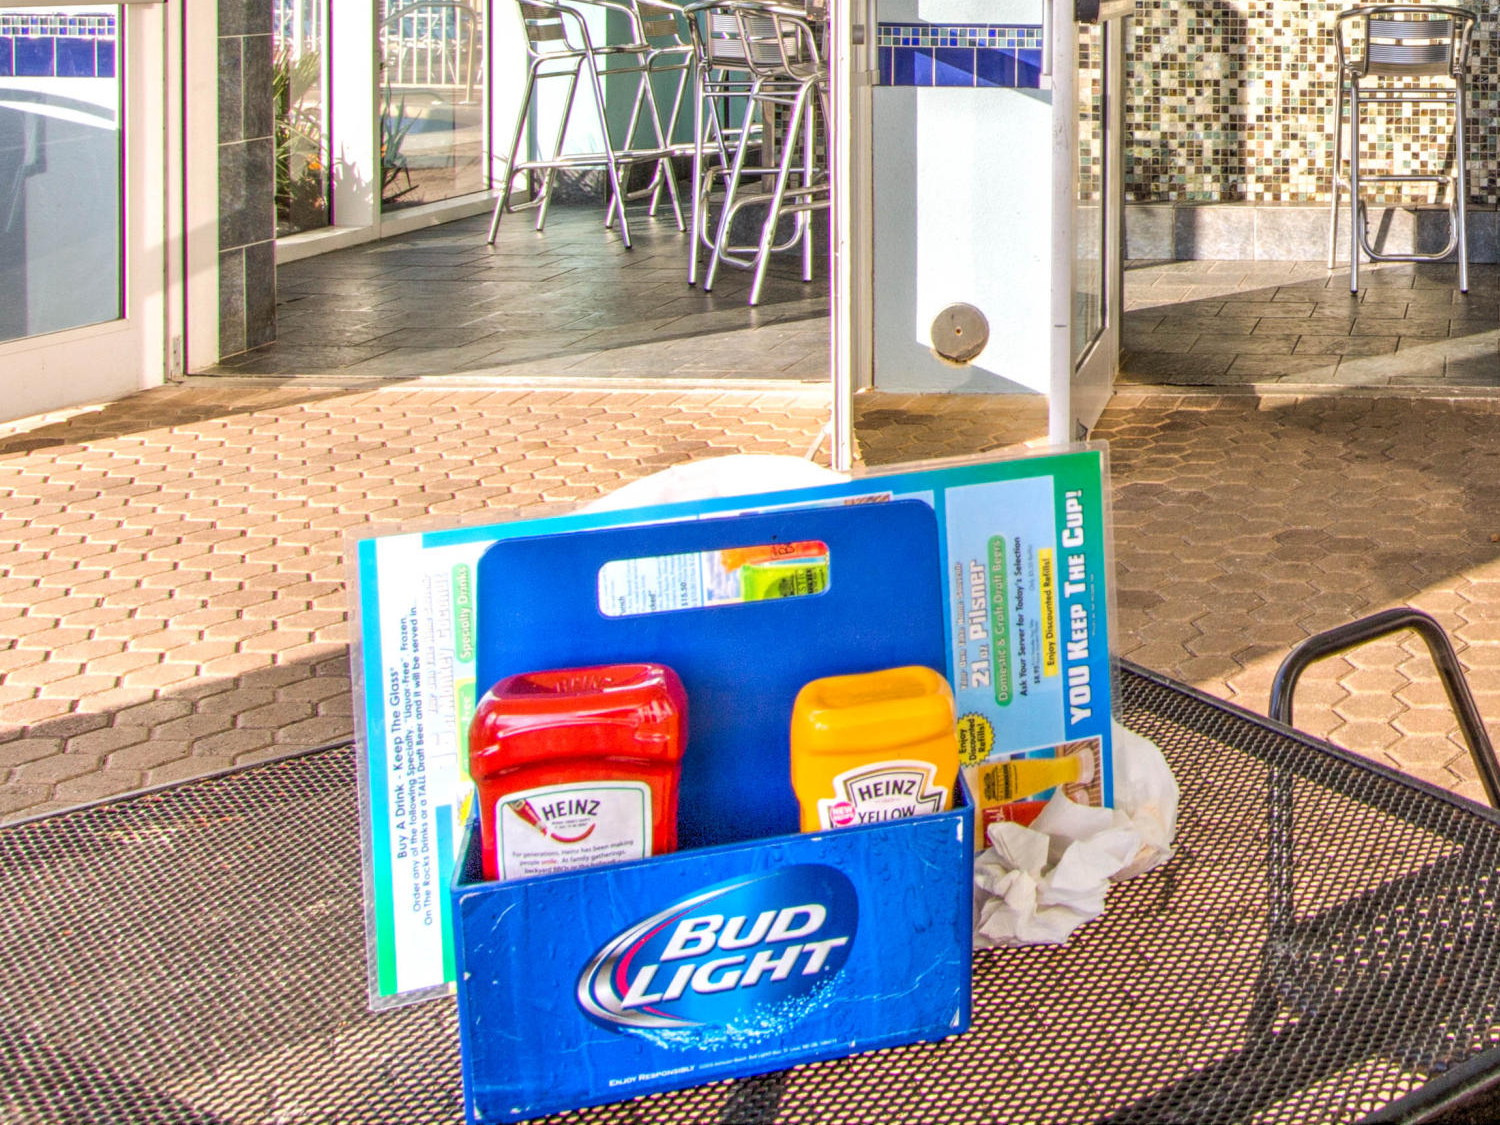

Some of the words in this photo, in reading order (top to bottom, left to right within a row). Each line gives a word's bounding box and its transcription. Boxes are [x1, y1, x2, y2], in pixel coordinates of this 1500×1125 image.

[1062, 489, 1084, 548] CUP!
[992, 540, 1002, 571] Beers
[1012, 537, 1022, 576] Selection
[456, 567, 468, 603] Drinks
[1043, 558, 1051, 587] Refills!
[1063, 554, 1086, 598] THE
[968, 560, 988, 640] Pilsner
[993, 575, 1003, 603] Draft
[1014, 578, 1024, 612] Today's
[994, 607, 1005, 634] Craft
[1016, 614, 1024, 626] for
[1043, 590, 1054, 638] Discounted
[410, 619, 419, 652] served
[459, 607, 473, 659] Specialty
[997, 638, 1004, 646] &
[1017, 628, 1026, 656] Server
[1066, 604, 1089, 660] KEEP
[411, 657, 419, 669] be
[1046, 641, 1056, 665] Enjoy
[412, 673, 420, 688] will
[971, 660, 990, 688] 21
[997, 650, 1008, 702] Domestic
[1018, 659, 1026, 677] Your
[1019, 680, 1028, 696] Ask
[1068, 666, 1092, 725] YOU
[391, 711, 401, 732] The
[414, 700, 422, 719] and
[959, 729, 968, 753] Enjoy
[968, 718, 977, 761] Discounted
[978, 723, 987, 752] Refills!
[392, 737, 403, 770] Keep
[416, 749, 425, 771] Draft
[393, 784, 405, 816] Drink
[417, 775, 426, 797] TALL
[858, 779, 917, 802] HEINZ
[408, 780, 418, 825] following
[420, 810, 427, 819] or
[542, 799, 601, 821] HEINZ
[858, 804, 916, 824] YELLOW
[396, 821, 405, 829] A
[409, 829, 417, 843] the
[420, 823, 428, 852] Drinks
[397, 836, 409, 858] Buy
[410, 847, 418, 855] of
[411, 860, 421, 879] any
[422, 856, 431, 885] Rocks
[412, 883, 421, 912] Order
[423, 890, 431, 906] The
[424, 911, 432, 925] On
[660, 903, 826, 963] BUD
[620, 936, 849, 1009] LIGHT
[608, 1075, 636, 1088] ENJOY
[638, 1065, 695, 1082] RESPONSIBLY
